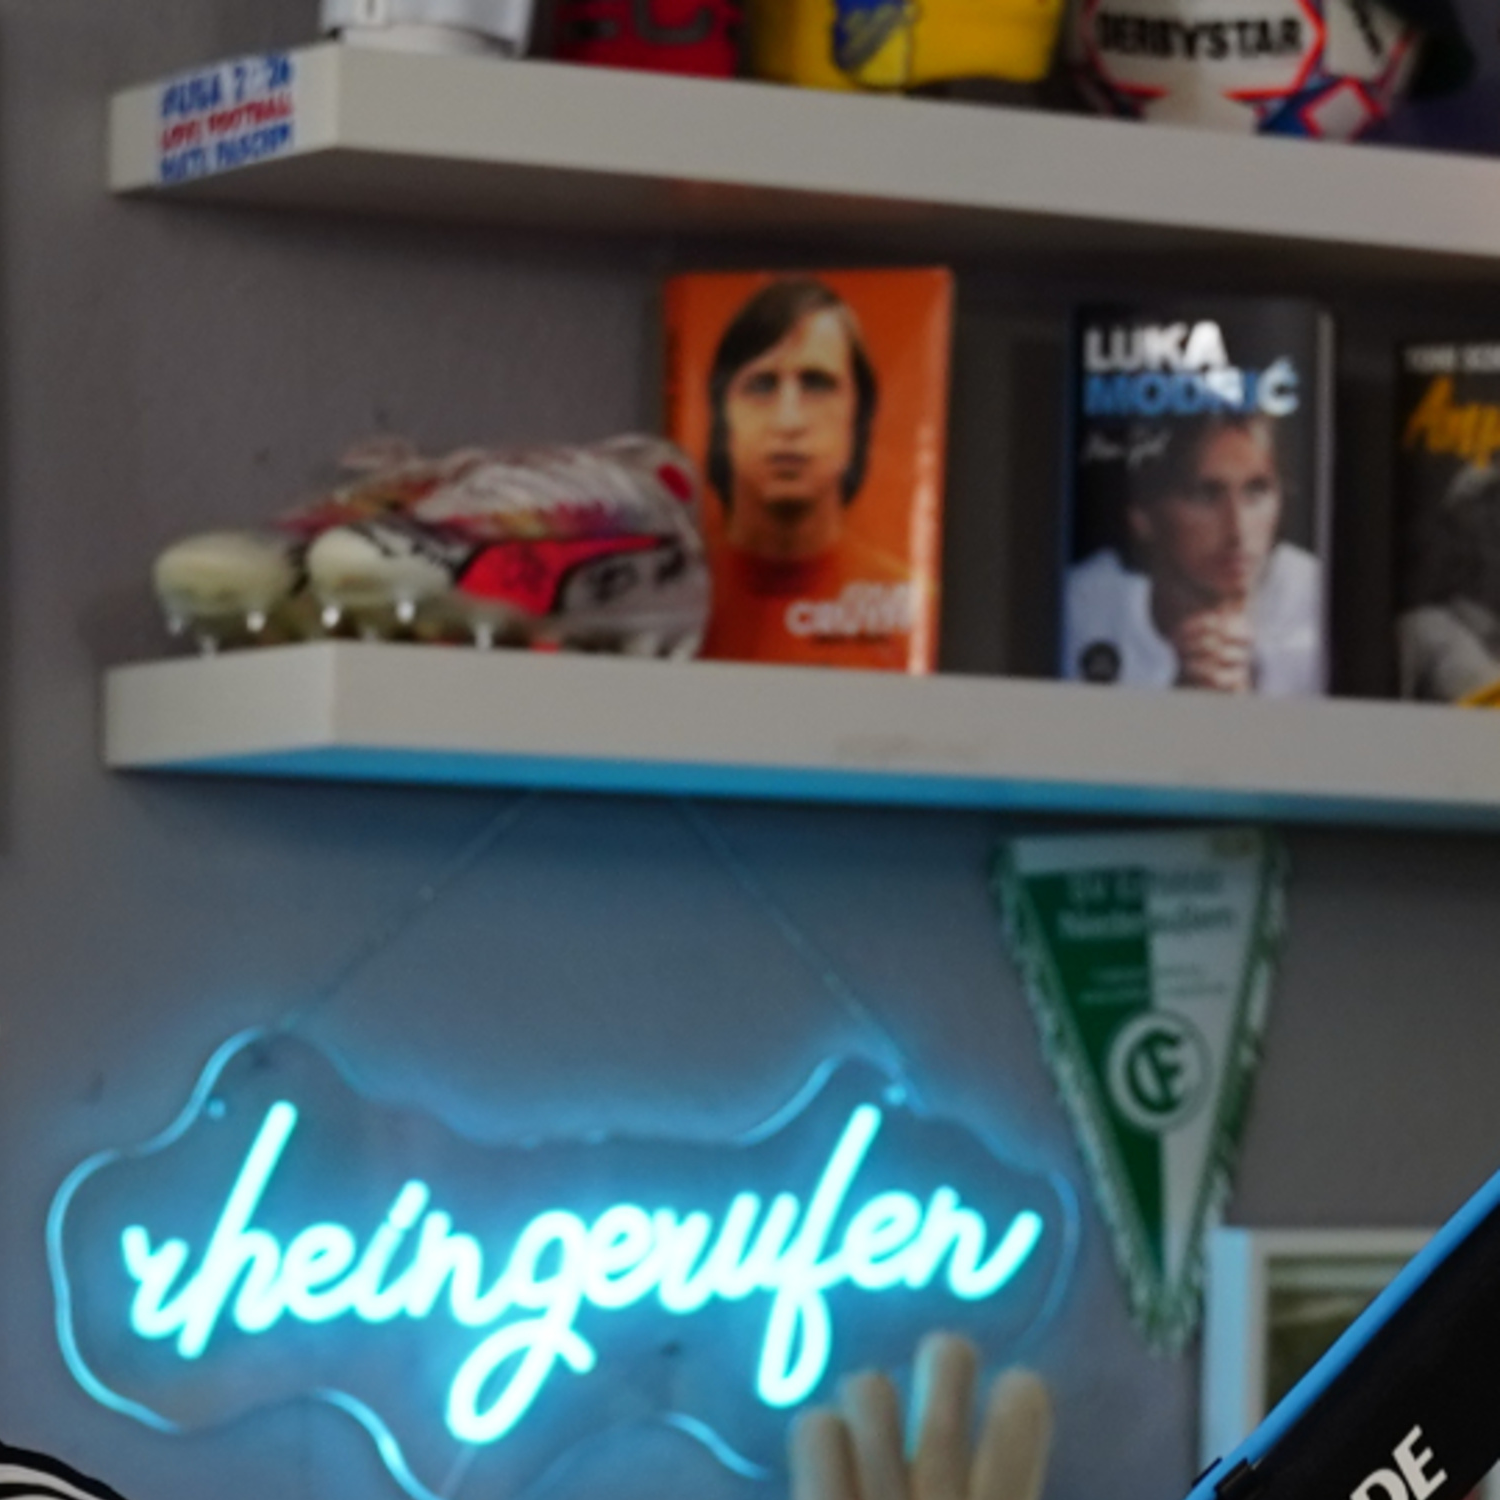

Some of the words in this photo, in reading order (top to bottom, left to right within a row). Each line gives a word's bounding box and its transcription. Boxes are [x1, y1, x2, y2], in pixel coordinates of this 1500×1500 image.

[1097, 15, 1301, 60] DERBYSTAR
[1084, 319, 1230, 373] LUKA
[1084, 354, 1300, 419] MODRIĆ
[121, 1099, 1043, 1445] rheingerufen
